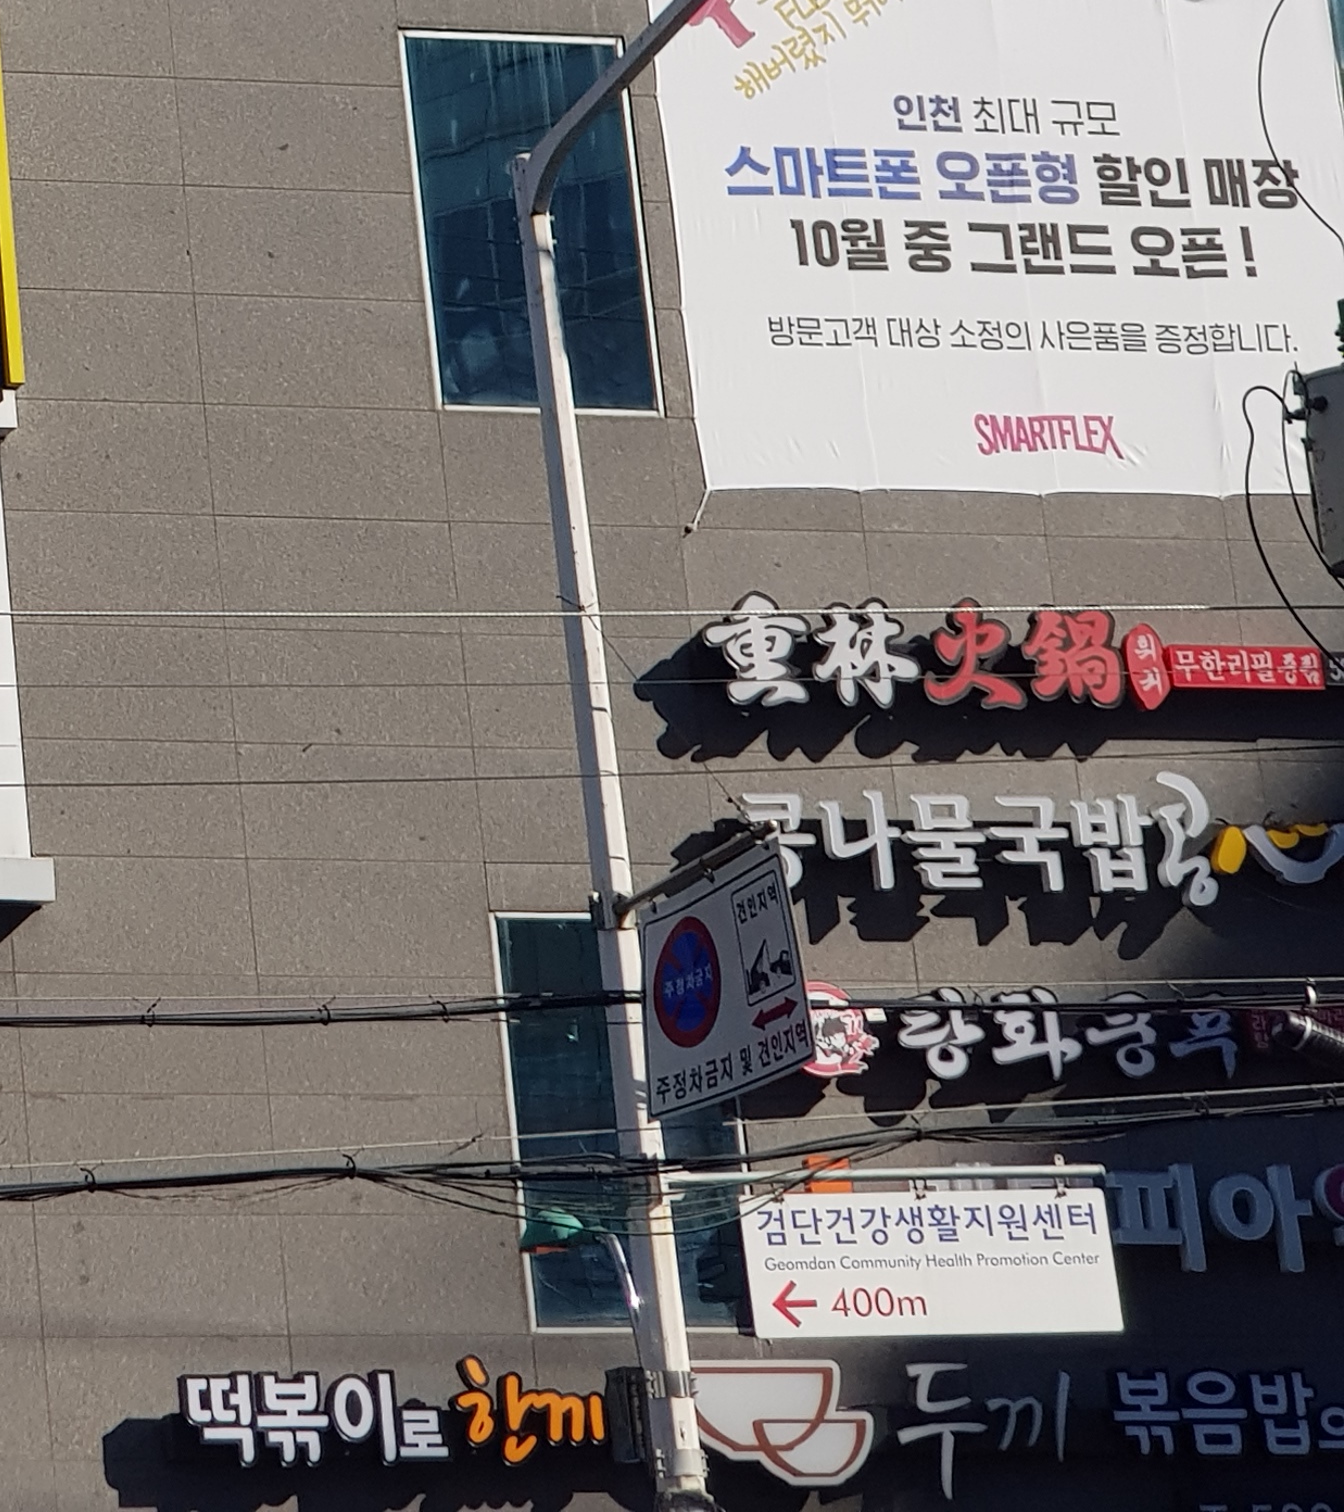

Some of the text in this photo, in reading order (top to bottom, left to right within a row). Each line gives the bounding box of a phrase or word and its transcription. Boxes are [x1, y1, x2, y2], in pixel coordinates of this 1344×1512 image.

[733, 10, 847, 100] 해버렸지
[893, 93, 1121, 138] 인천 최대 규모
[724, 144, 1301, 211] 스마트폰 오픈형 할인 매장
[789, 218, 889, 272] 10월
[903, 219, 953, 275] 중
[969, 221, 1117, 276] 그랜드
[767, 315, 1299, 356] 방문고객 대상 소정의 사은품을 증정합니다.
[973, 413, 1125, 461] SMARTFLEX
[1174, 648, 1277, 685] 무한리필
[735, 881, 780, 925] 견인지역
[655, 1018, 811, 1106] 주정차금지 및 견인지역
[757, 1201, 1097, 1246] 검단건강생활지원센터
[764, 1250, 1100, 1273] Geomdan Community Health Promotion Center
[830, 1287, 929, 1318] 400m
[182, 1370, 451, 1467] 떡볶이로
